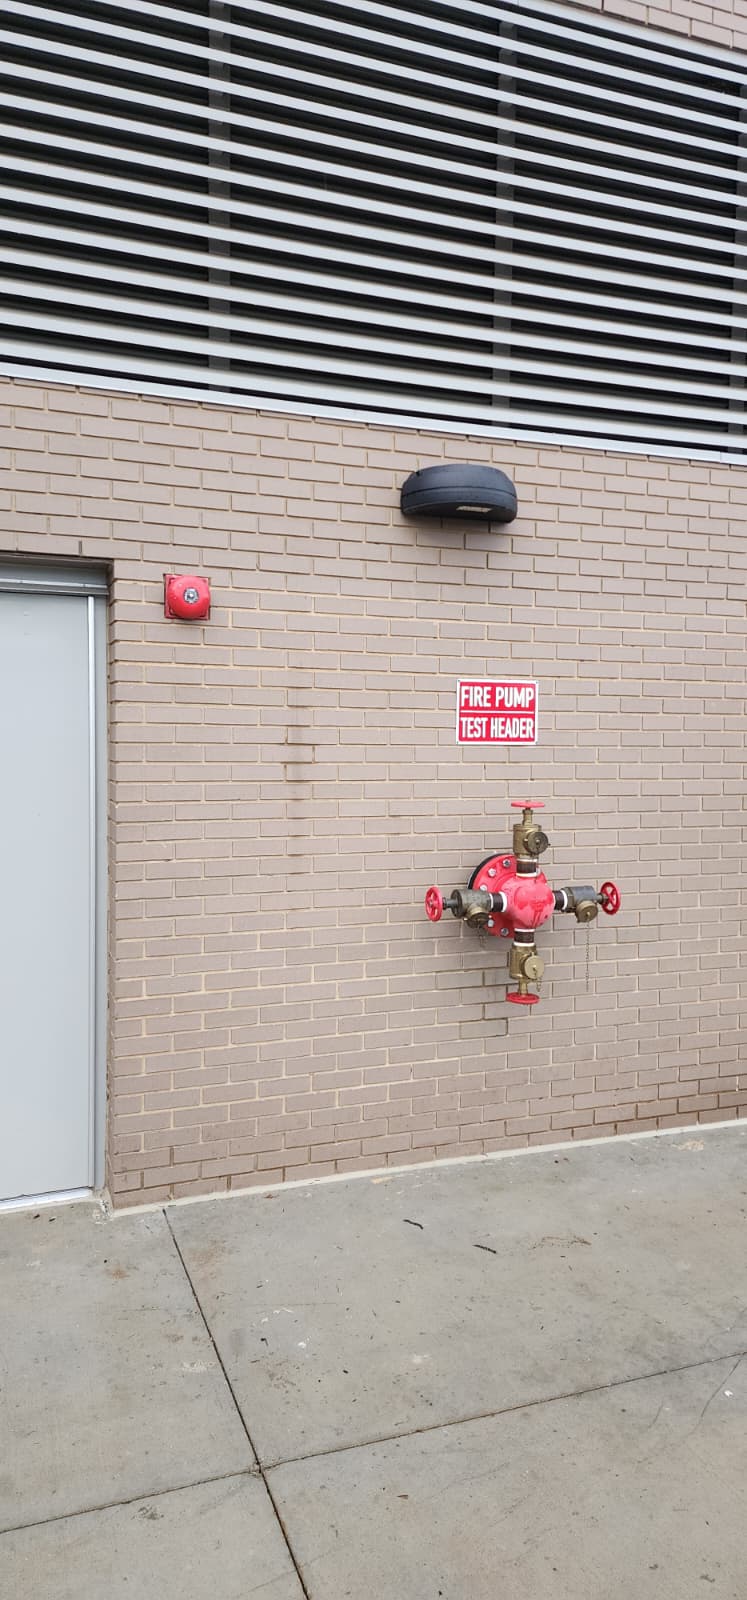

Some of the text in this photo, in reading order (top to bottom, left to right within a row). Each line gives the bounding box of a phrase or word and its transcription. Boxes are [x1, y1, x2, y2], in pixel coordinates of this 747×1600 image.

[461, 685, 534, 708] FIRE PUMP
[460, 717, 534, 738] TEST HEADER
